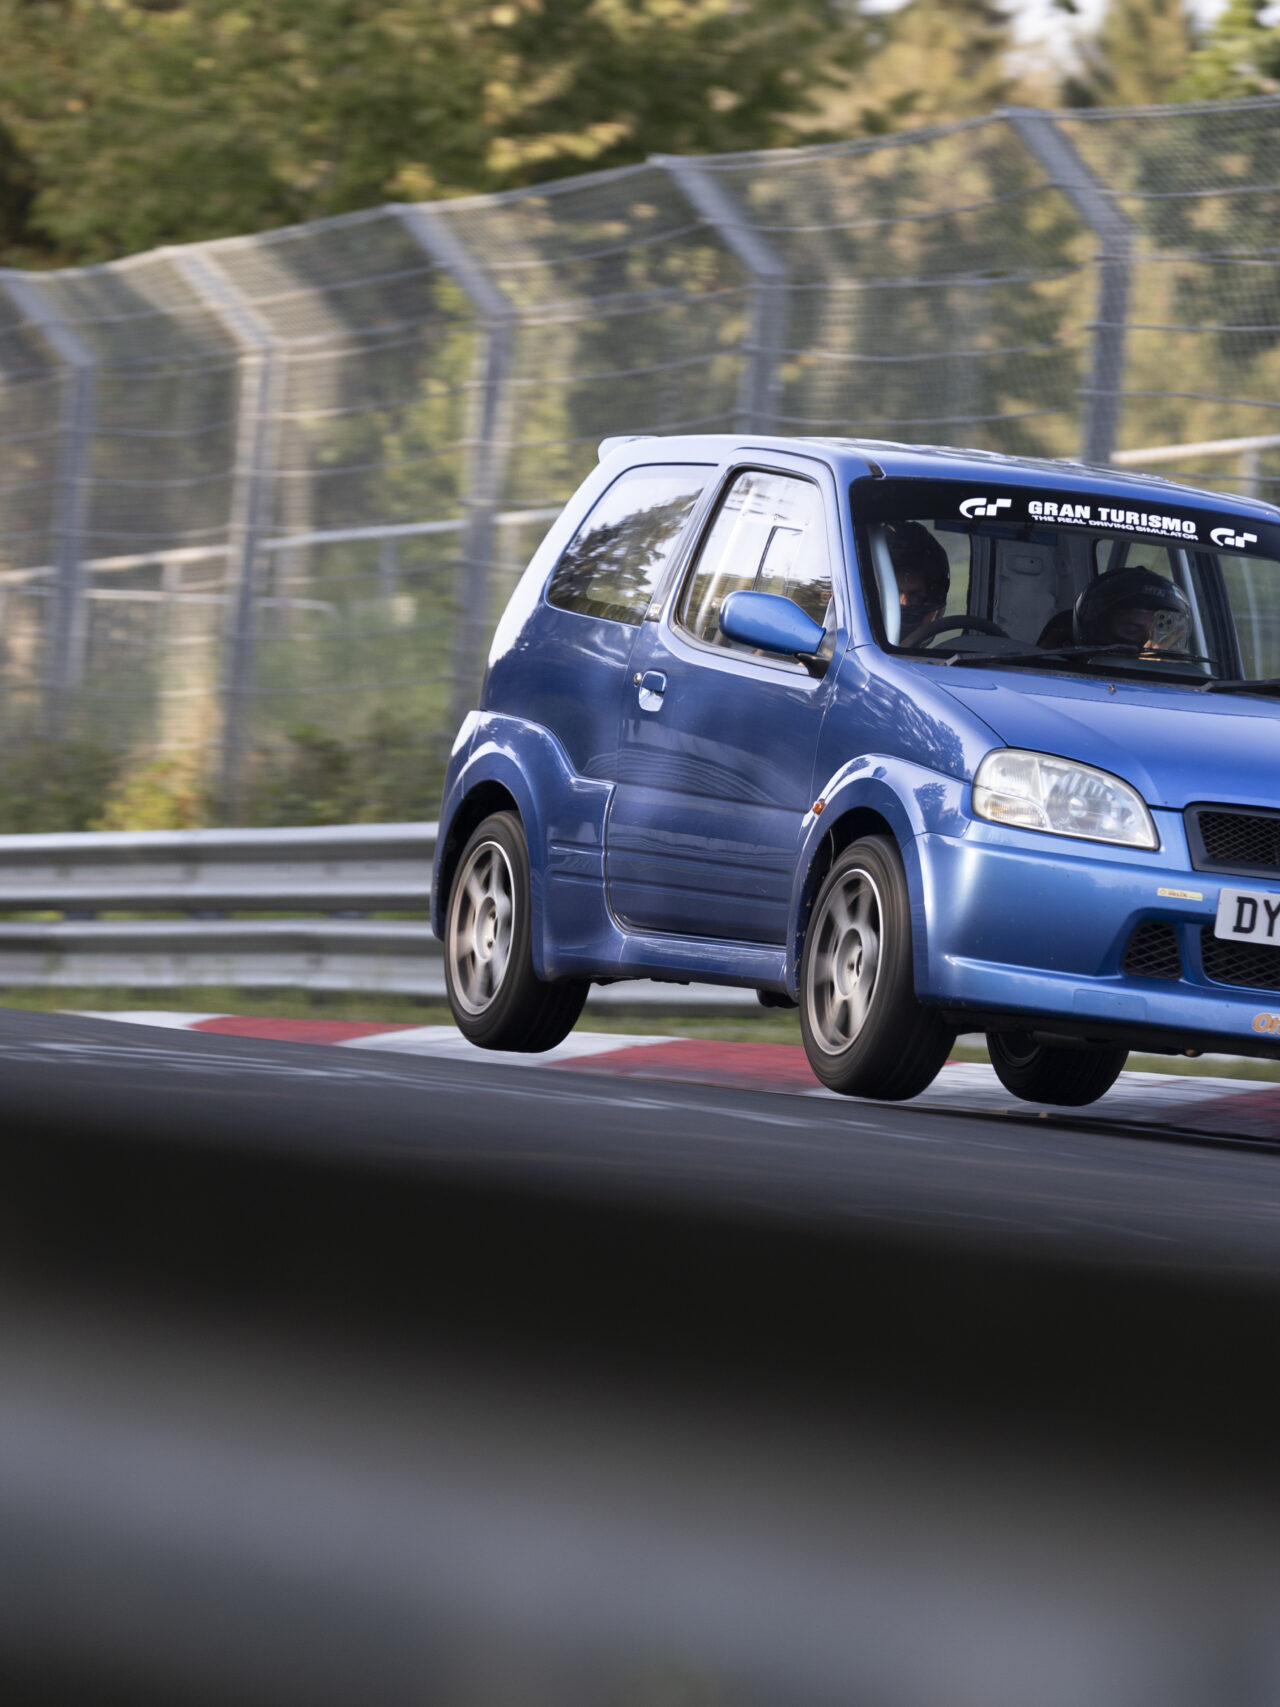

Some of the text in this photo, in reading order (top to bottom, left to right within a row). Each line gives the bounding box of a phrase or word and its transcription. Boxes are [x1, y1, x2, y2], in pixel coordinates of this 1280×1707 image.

[1028, 501, 1196, 533] GRAN TURISMO
[1032, 515, 1199, 541] THE REAL DRIVING SIMULATOR
